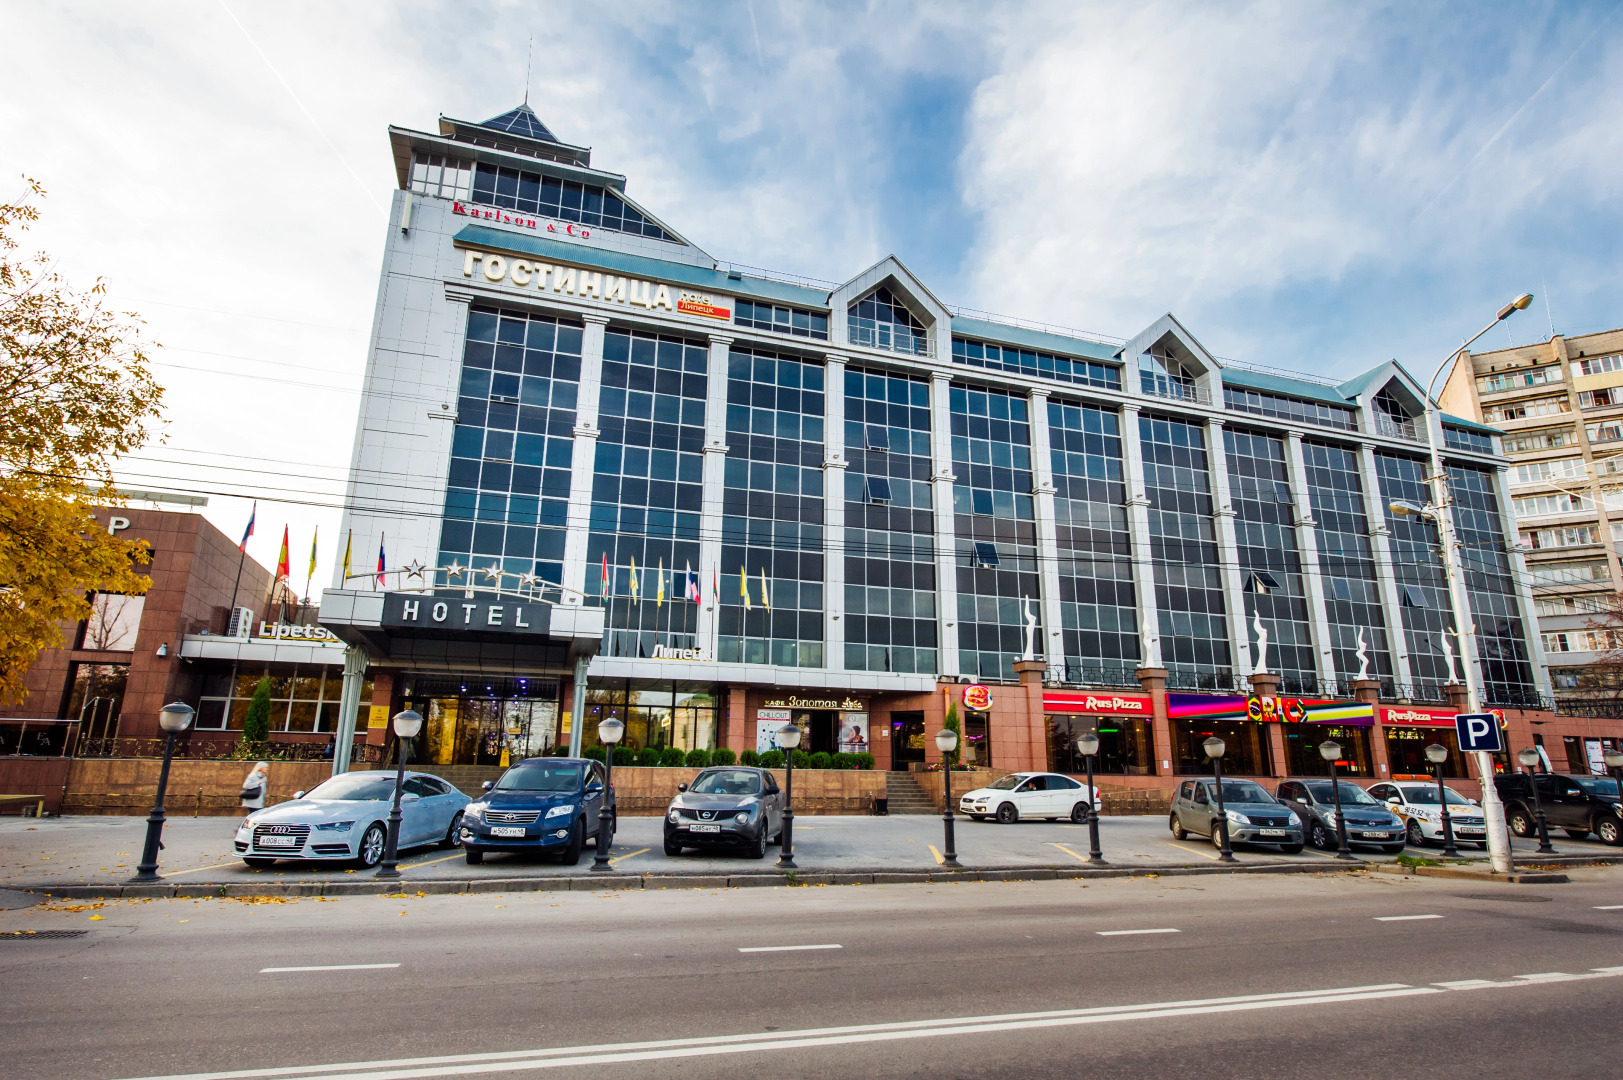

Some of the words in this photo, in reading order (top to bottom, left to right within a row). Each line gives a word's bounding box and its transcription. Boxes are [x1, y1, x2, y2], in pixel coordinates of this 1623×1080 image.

[453, 201, 536, 229] Karlson
[547, 223, 556, 233] &
[566, 224, 590, 239] Co
[464, 250, 672, 311] ГОСТИНИЦА
[680, 302, 714, 314] Липецк
[681, 289, 714, 306] hotel
[402, 600, 530, 628] HOTEL
[1248, 697, 1308, 723] BRICS
[1466, 718, 1490, 747] P
